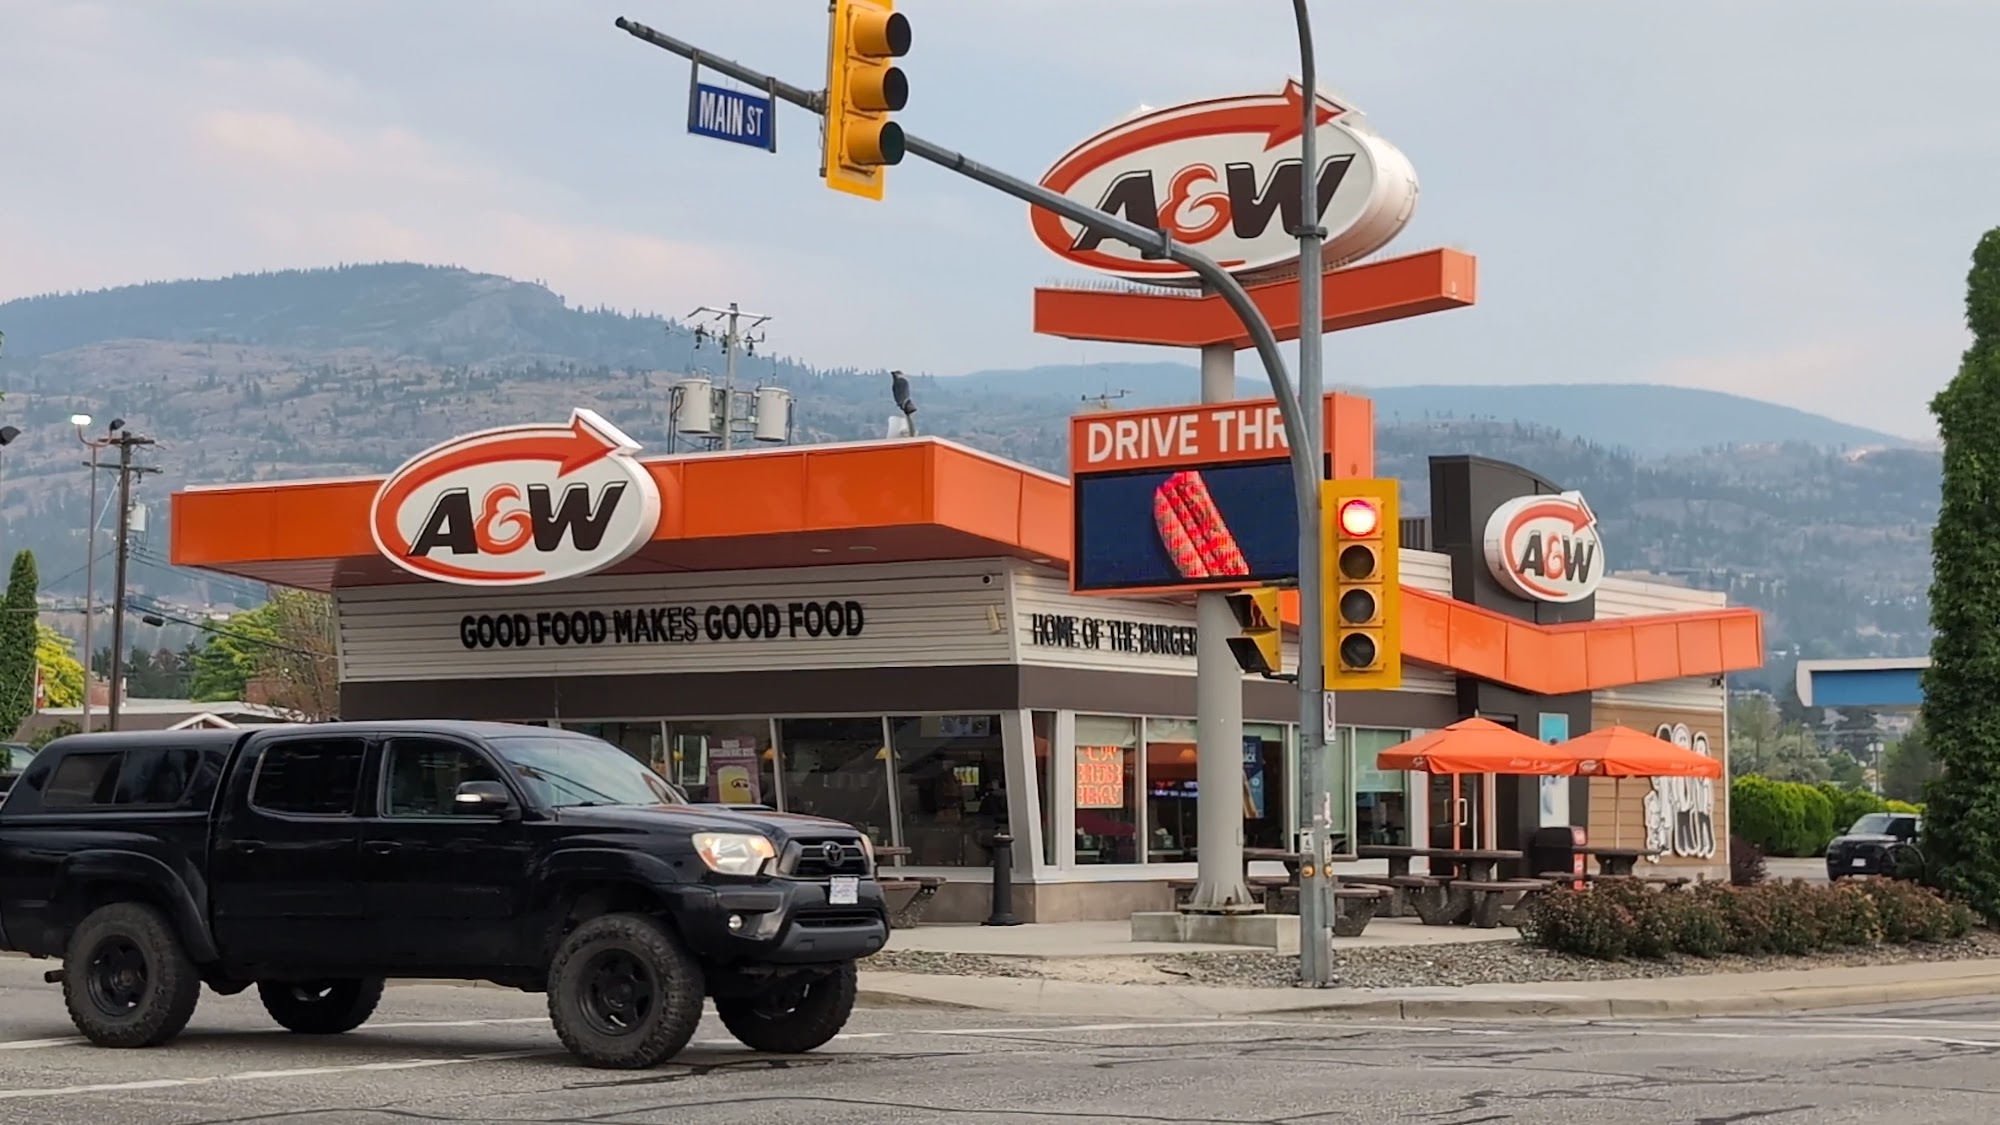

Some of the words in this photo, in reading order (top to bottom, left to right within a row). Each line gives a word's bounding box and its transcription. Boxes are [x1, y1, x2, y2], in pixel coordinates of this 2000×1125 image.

[699, 90, 743, 136] MAIN
[747, 105, 763, 137] ST
[1068, 153, 1356, 251] A&W
[1088, 414, 1199, 463] DRIVE
[1212, 407, 1290, 453] THR
[406, 481, 628, 557] A&W
[1516, 529, 1596, 584] A&W
[460, 614, 531, 649] GOOD
[537, 610, 607, 645] FOOD
[613, 607, 698, 643] MAKES
[704, 603, 781, 641] GOOD
[788, 600, 864, 638] FOOD
[1032, 613, 1080, 649] HOME
[1082, 617, 1105, 650] OF
[1106, 620, 1138, 653] THE
